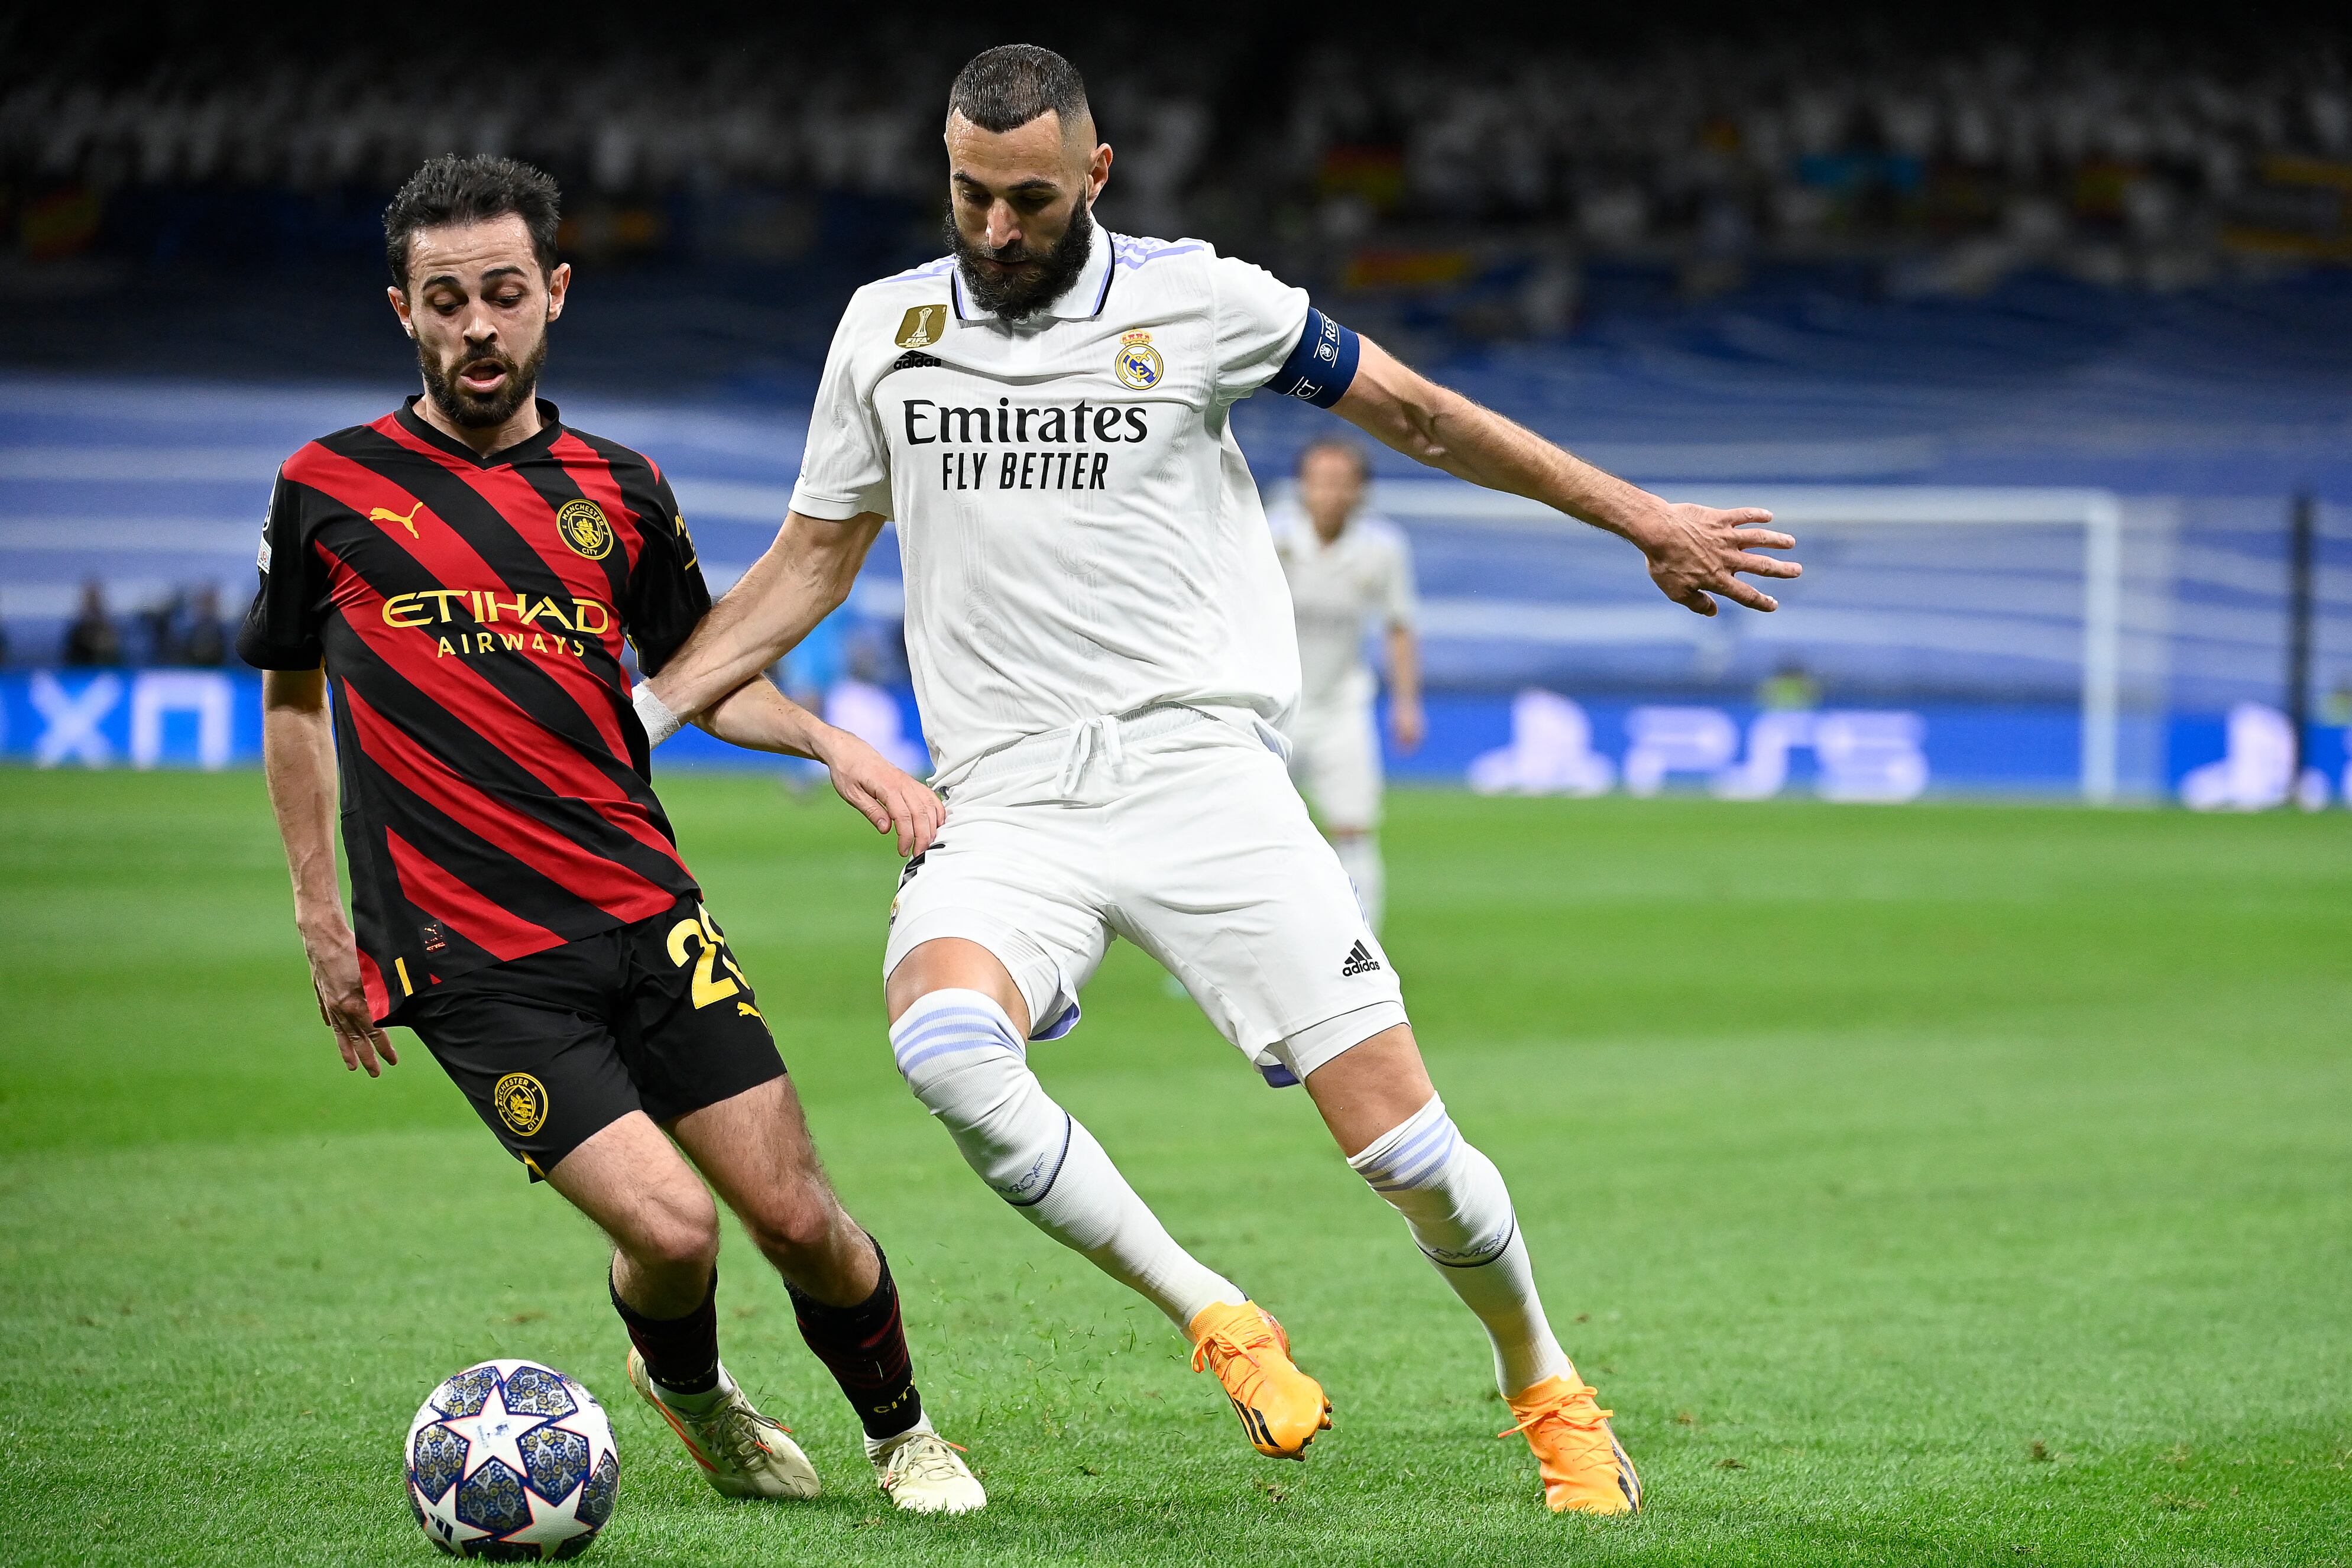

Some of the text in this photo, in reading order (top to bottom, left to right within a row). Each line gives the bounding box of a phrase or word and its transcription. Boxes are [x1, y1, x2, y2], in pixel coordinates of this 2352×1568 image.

[893, 356, 941, 370] adidas
[903, 397, 1148, 445] Emirates
[942, 452, 1109, 491] FLY BETTER
[562, 504, 604, 526] MANCHESTER
[381, 589, 609, 634] ETIHAD
[437, 631, 585, 658] AIRWAYS
[1343, 959, 1381, 977] adidas
[527, 1115, 540, 1130] CITY
